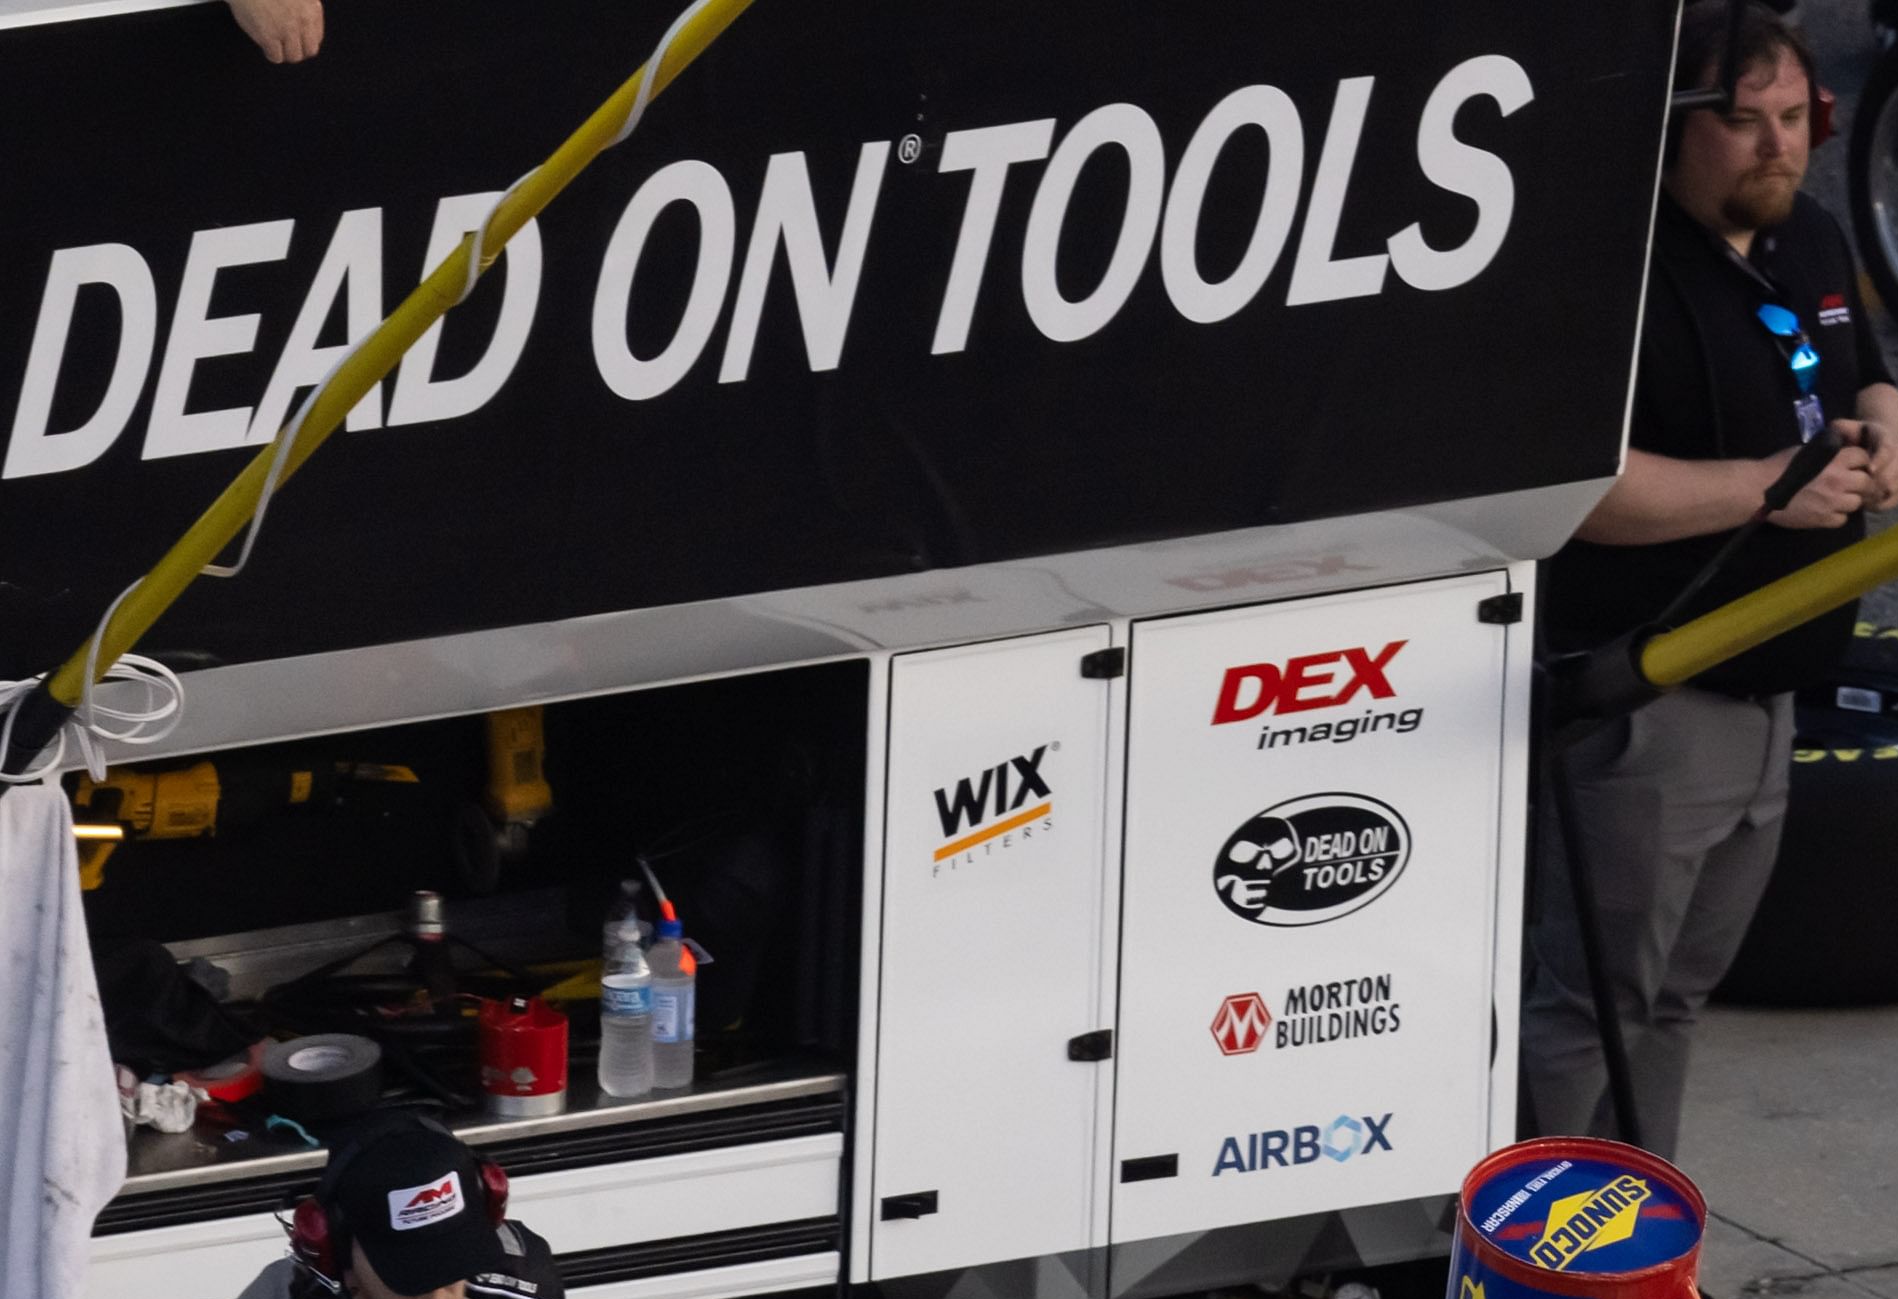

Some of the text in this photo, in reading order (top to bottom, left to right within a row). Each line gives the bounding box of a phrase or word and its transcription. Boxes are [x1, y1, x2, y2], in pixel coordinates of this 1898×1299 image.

[2, 54, 1536, 480] DEAD ON TOOLS
[1210, 639, 1410, 727] DEX
[1257, 706, 1424, 752] imaging
[933, 743, 1053, 839] WIX
[931, 816, 1053, 880] FILTERS
[1303, 857, 1386, 891] TOOLS
[1304, 825, 1389, 863] DEAD ON
[1284, 973, 1392, 1016] MORTON
[1275, 1004, 1402, 1050] BUILDINGS
[1211, 1111, 1394, 1177] AIRBOX
[1534, 1177, 1647, 1270] SUNOCO
